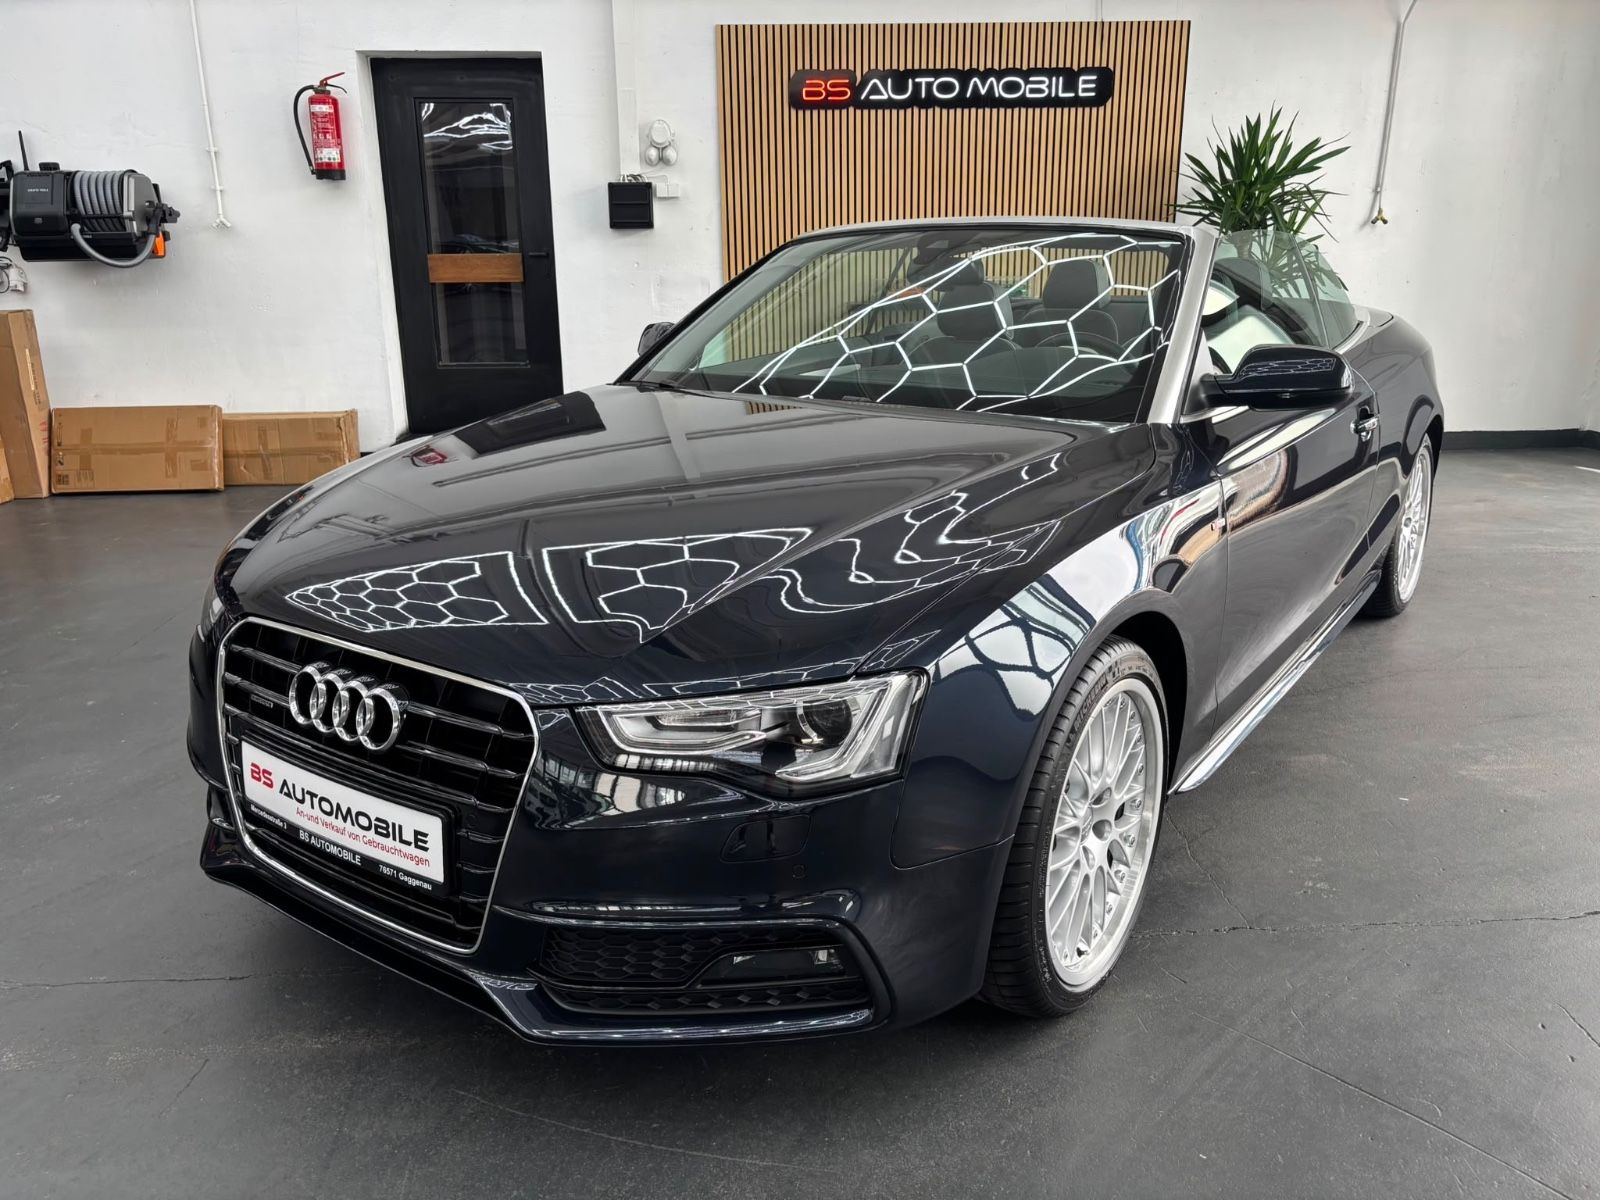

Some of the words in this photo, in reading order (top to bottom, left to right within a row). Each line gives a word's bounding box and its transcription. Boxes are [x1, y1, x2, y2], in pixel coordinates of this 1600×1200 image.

[802, 79, 851, 100] BS
[250, 762, 274, 789] BS
[279, 778, 430, 852] AUTOMOBILE
[299, 829, 310, 842] BS
[310, 834, 361, 866] AUTOMOBILE
[320, 818, 346, 837] Verkauf
[346, 831, 361, 843] von
[362, 834, 430, 868] Gebrauchtwagen
[398, 872, 432, 891] Gaggenau
